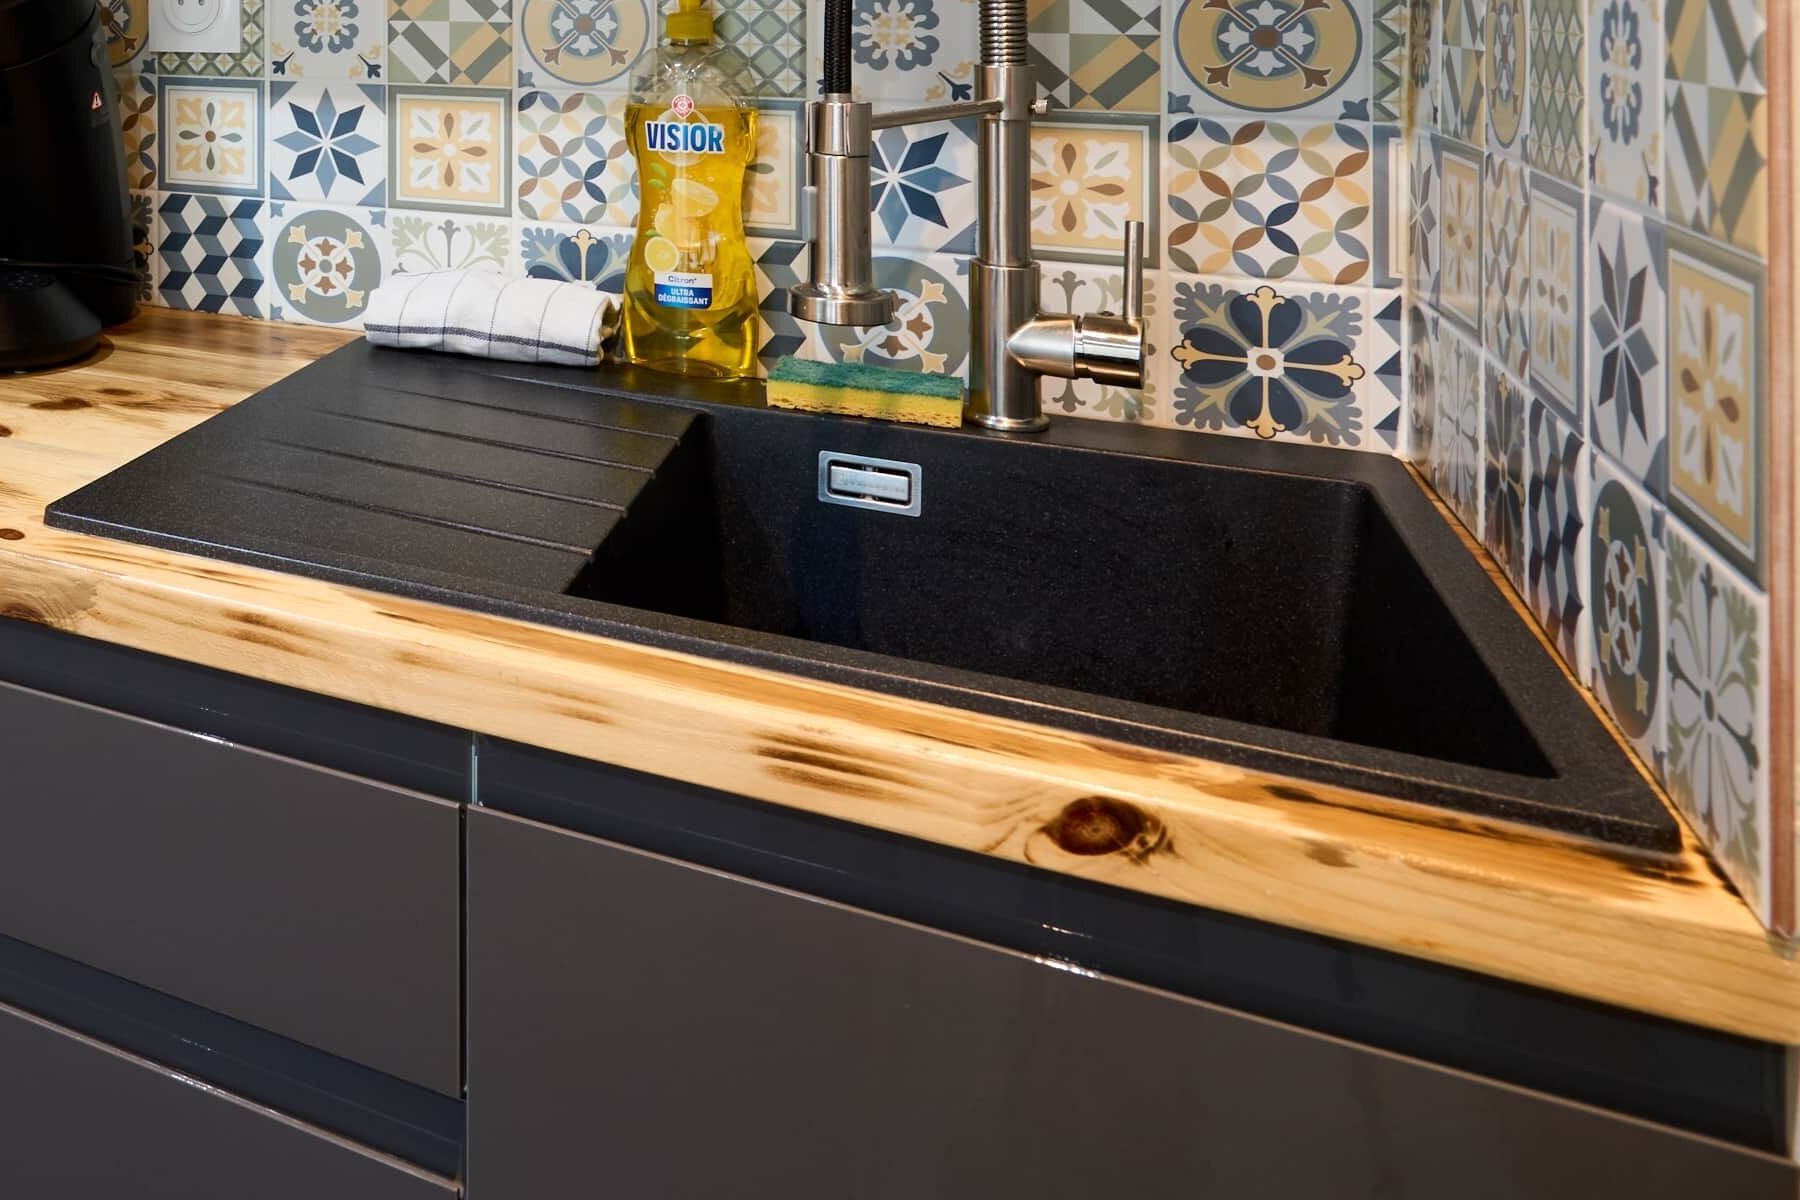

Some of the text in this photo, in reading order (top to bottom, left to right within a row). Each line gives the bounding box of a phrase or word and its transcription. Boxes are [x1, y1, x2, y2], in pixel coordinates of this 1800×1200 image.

[646, 122, 724, 152] VISIOR
[671, 288, 694, 297] ULTRA
[658, 293, 708, 305] DÉGRAISSANT
